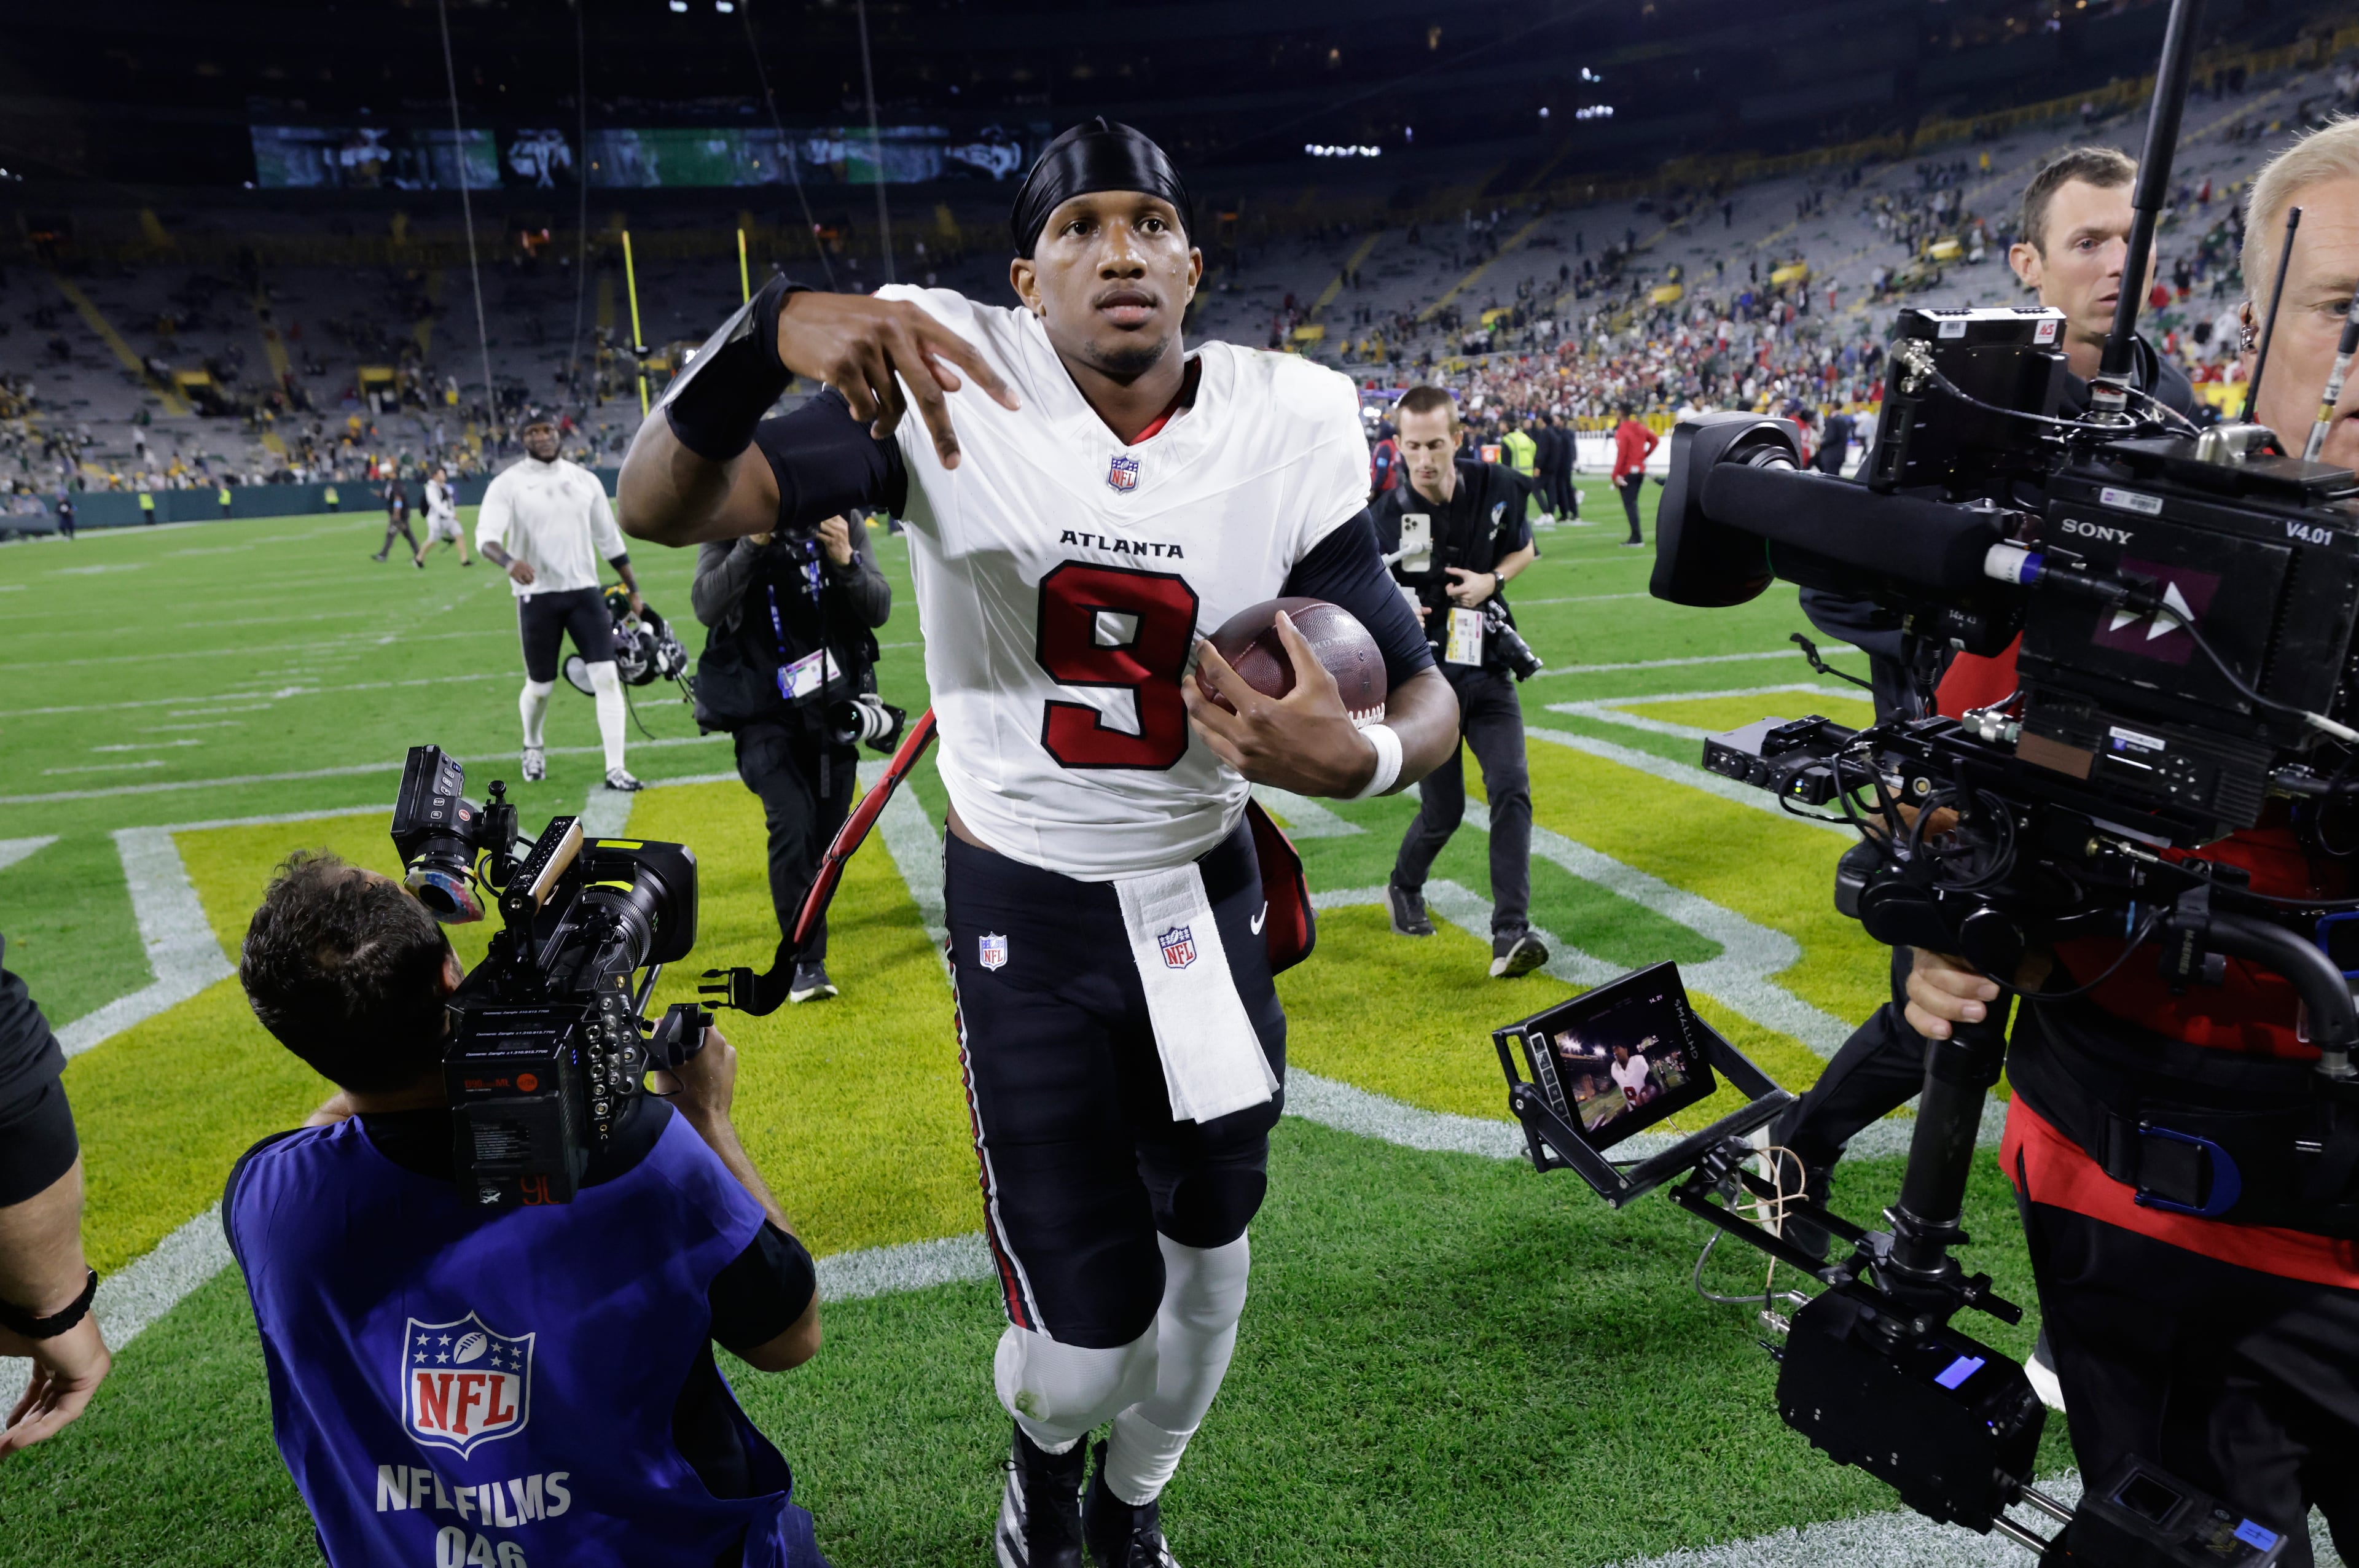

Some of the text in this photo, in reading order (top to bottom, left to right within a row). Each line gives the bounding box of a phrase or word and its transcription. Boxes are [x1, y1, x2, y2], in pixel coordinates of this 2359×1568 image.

[1111, 469, 1133, 486] NFL
[1060, 529, 1184, 558] ATLANTA
[2061, 518, 2134, 545] SONY
[2287, 521, 2333, 546] V4.01
[1036, 560, 1199, 770] 9
[984, 949, 1003, 964] NFL
[1165, 942, 1194, 965] NFL
[1674, 999, 1699, 1059] SMALLHD
[417, 1373, 514, 1435] NFL
[376, 1464, 571, 1528] NFL FILMS
[436, 1526, 528, 1568] 046
